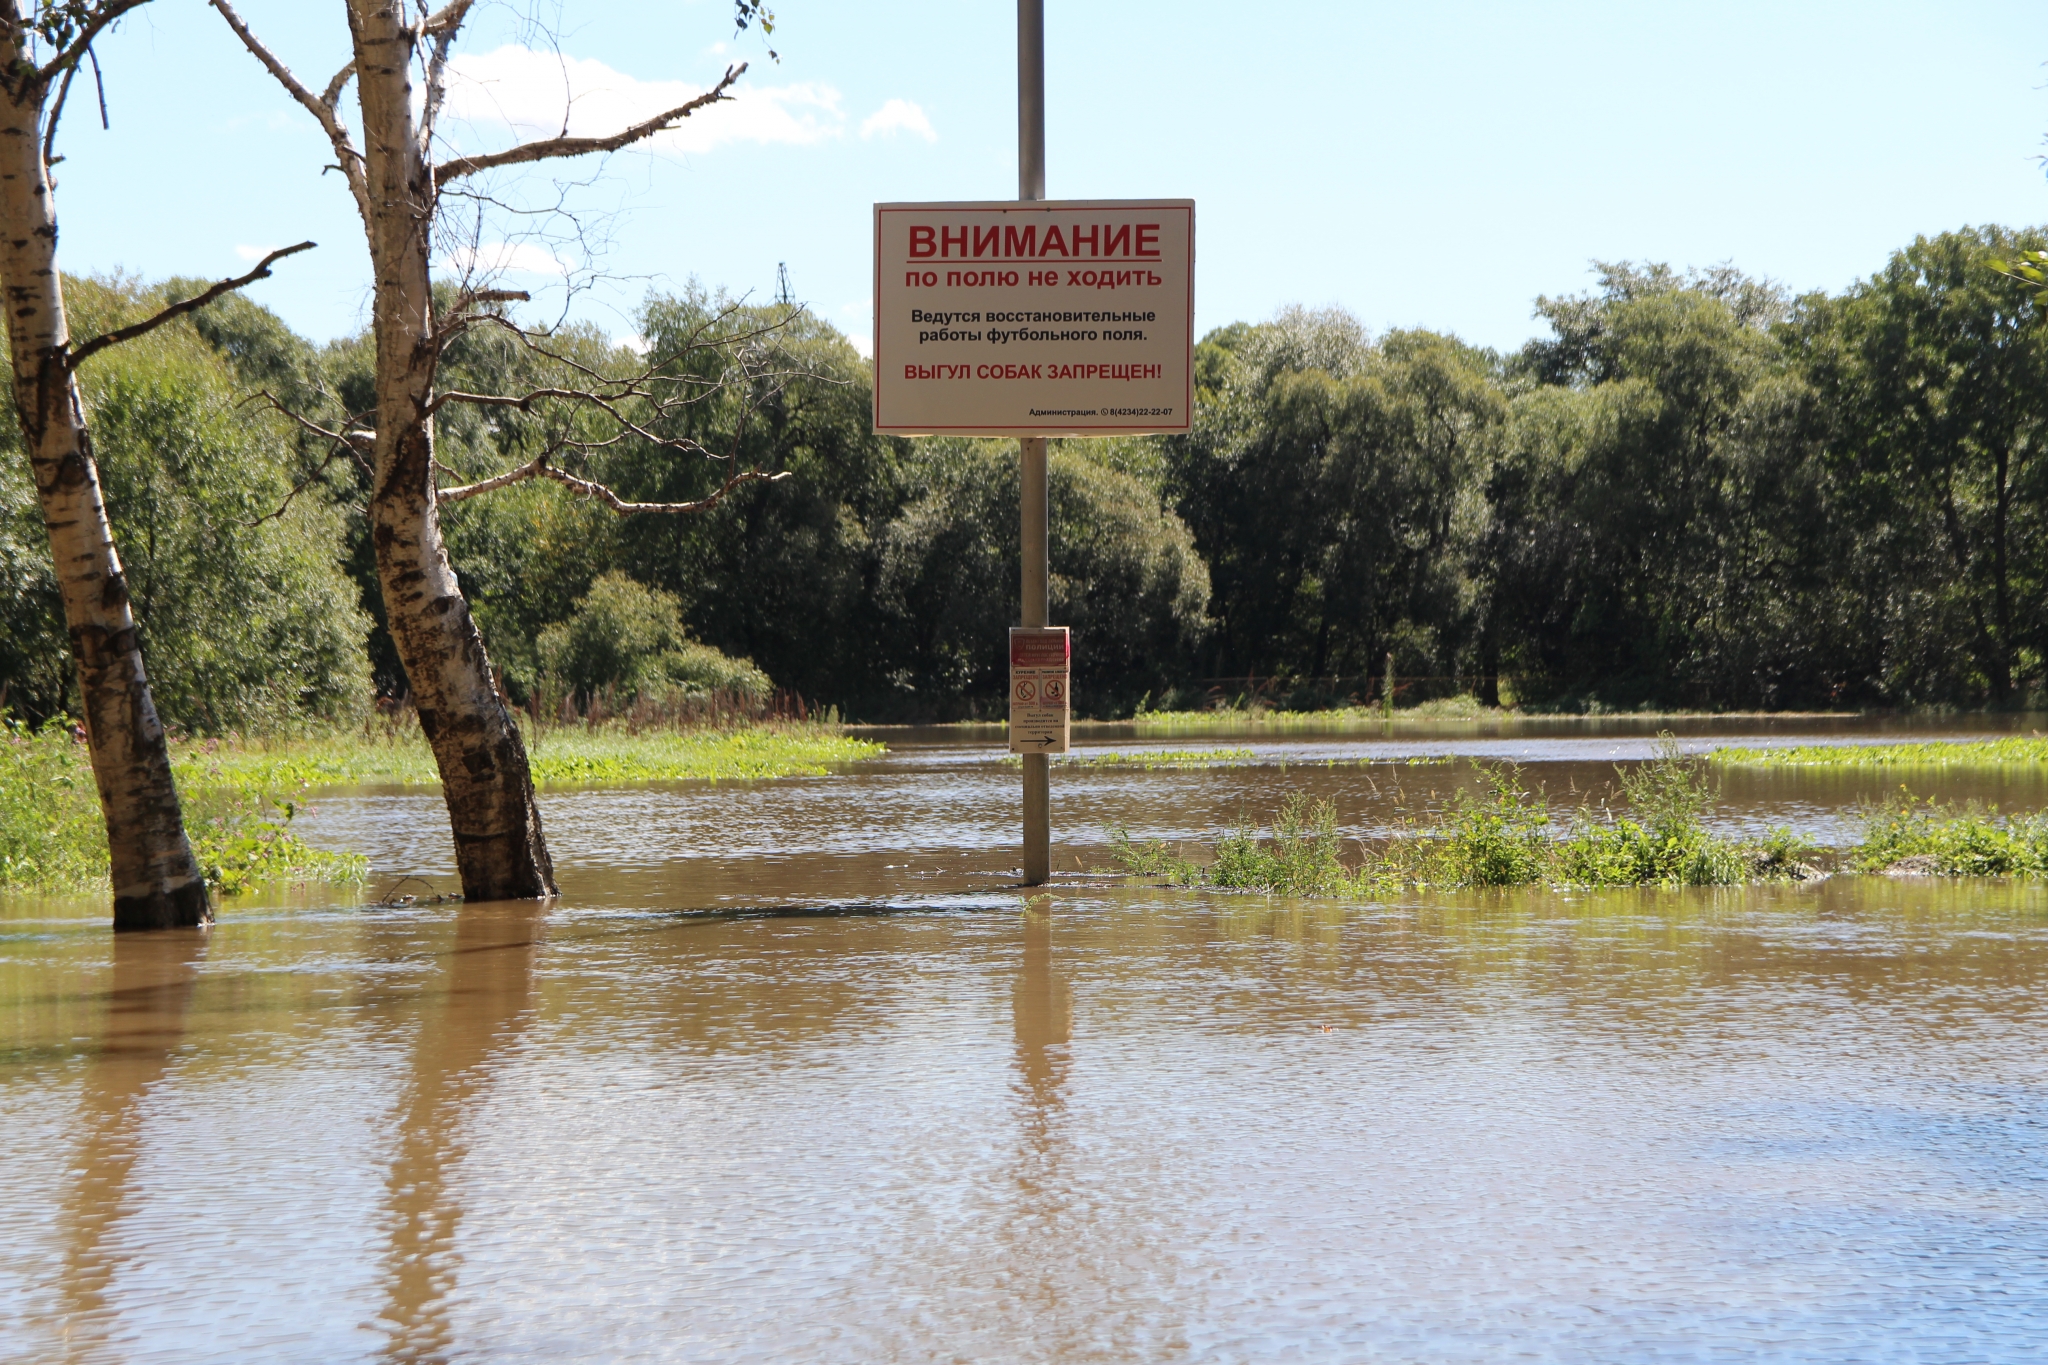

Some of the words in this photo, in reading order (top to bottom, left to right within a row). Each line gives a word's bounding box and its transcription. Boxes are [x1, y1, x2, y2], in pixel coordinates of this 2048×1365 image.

[909, 224, 1160, 257] ВНИМАНИЕ
[906, 272, 938, 287] по
[947, 271, 1019, 287] полю
[1029, 271, 1058, 286] не
[1067, 270, 1162, 289] ходить
[912, 310, 980, 325] Ведутся
[986, 310, 1155, 322] восстановительные
[919, 328, 981, 344] работы
[987, 328, 1097, 344] футбольного
[1103, 330, 1147, 341] поля.
[905, 365, 970, 379] ВЫГУЛ
[977, 364, 1042, 379] СОБАК
[1048, 364, 1161, 381] ЗАПРЕЩЕН!
[1029, 408, 1098, 417] Администрация.
[1110, 408, 1172, 416] 8(4234)22-22-07
